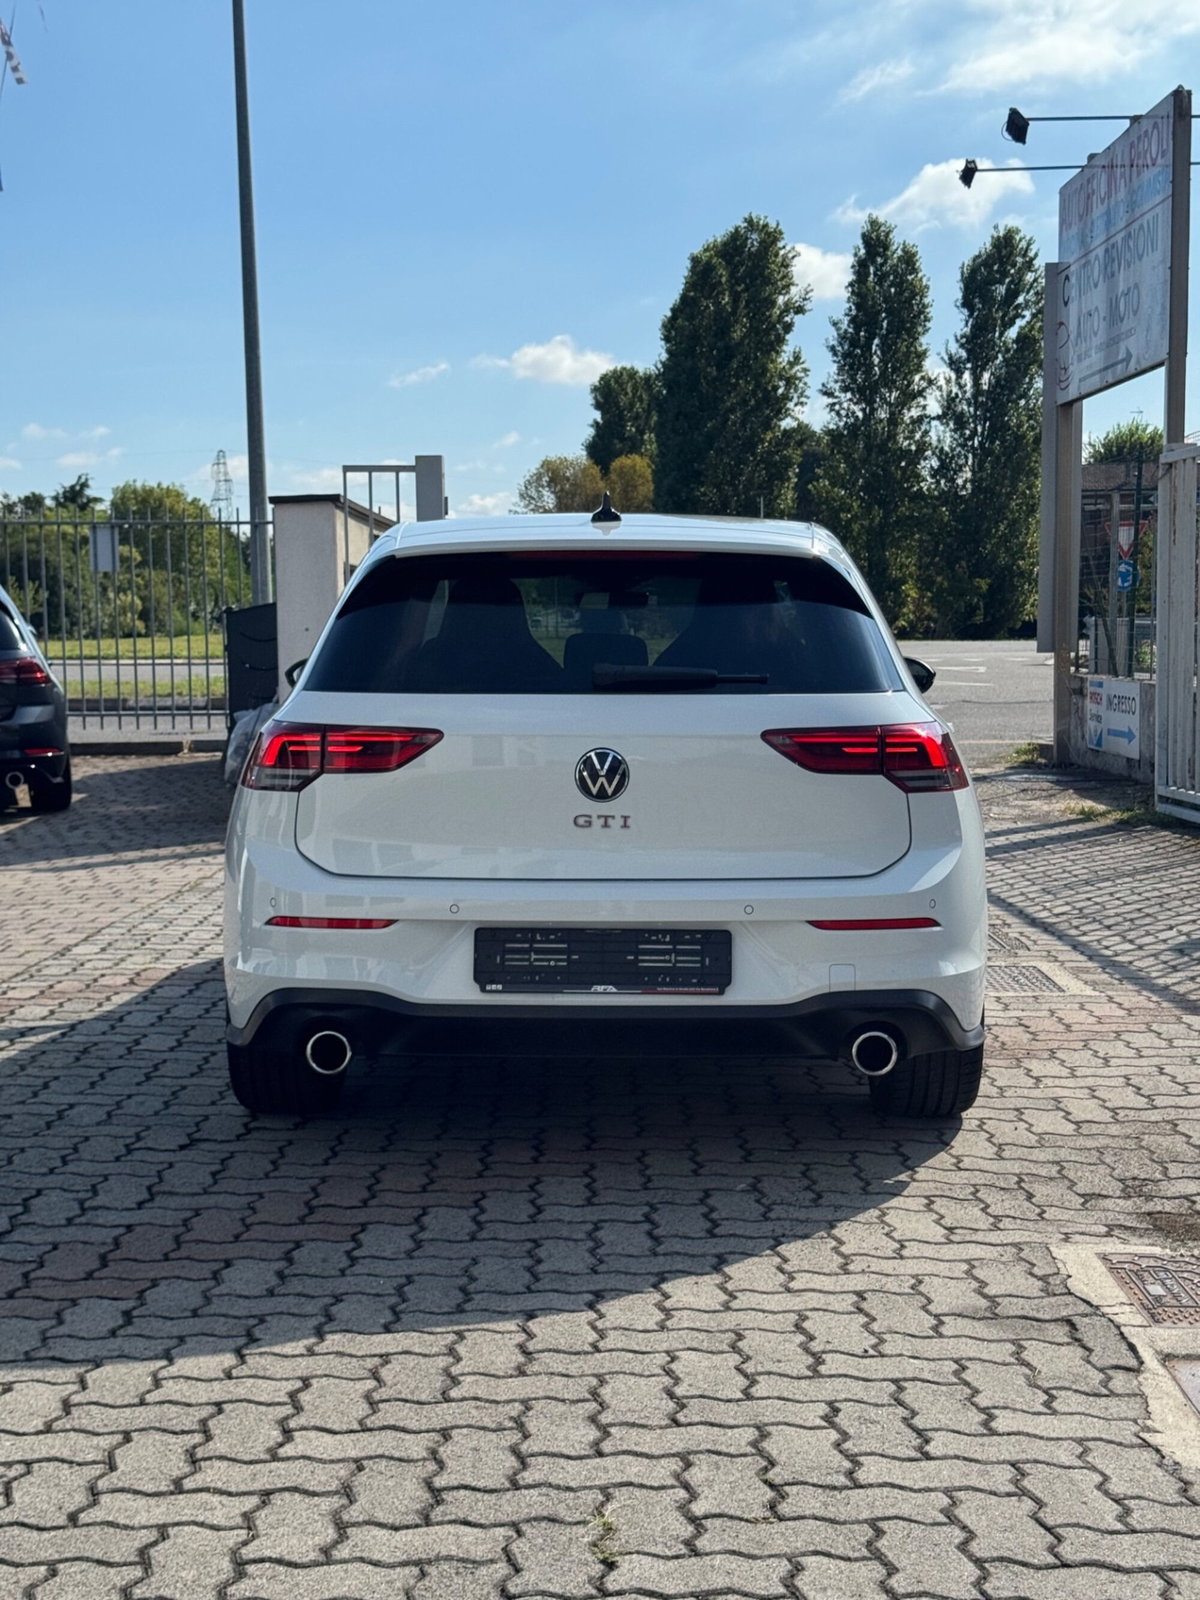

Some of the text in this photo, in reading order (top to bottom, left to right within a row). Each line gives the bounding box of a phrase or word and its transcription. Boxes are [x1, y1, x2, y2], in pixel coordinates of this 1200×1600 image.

[1130, 110, 1169, 184] PEROLI
[1103, 212, 1159, 282] REVISIONI
[1075, 305, 1100, 345] AUTO
[1108, 281, 1140, 330] MOTO
[1106, 694, 1136, 716] INGRESSO
[573, 814, 631, 829] GTI
